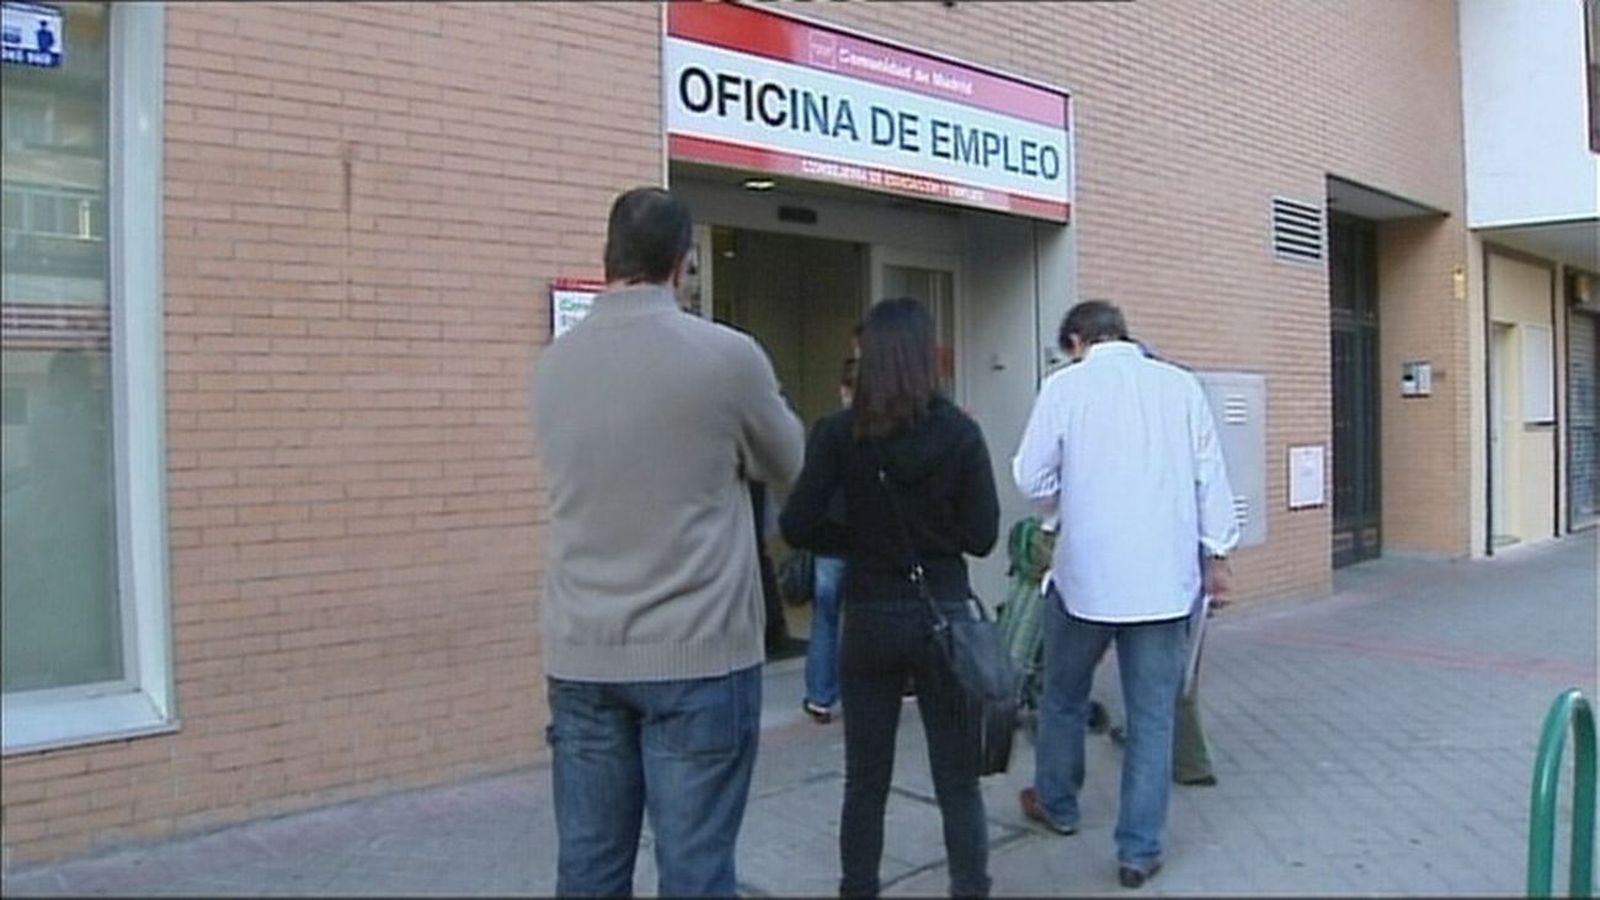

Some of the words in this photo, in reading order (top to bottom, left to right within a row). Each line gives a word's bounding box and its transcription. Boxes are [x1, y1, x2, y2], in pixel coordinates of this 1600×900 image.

[839, 47, 912, 80] Comunidad
[914, 68, 931, 84] de
[932, 72, 974, 95] Madrid
[679, 66, 860, 142] OFICINA
[870, 106, 919, 152] DE
[931, 121, 1060, 181] EMPLEO
